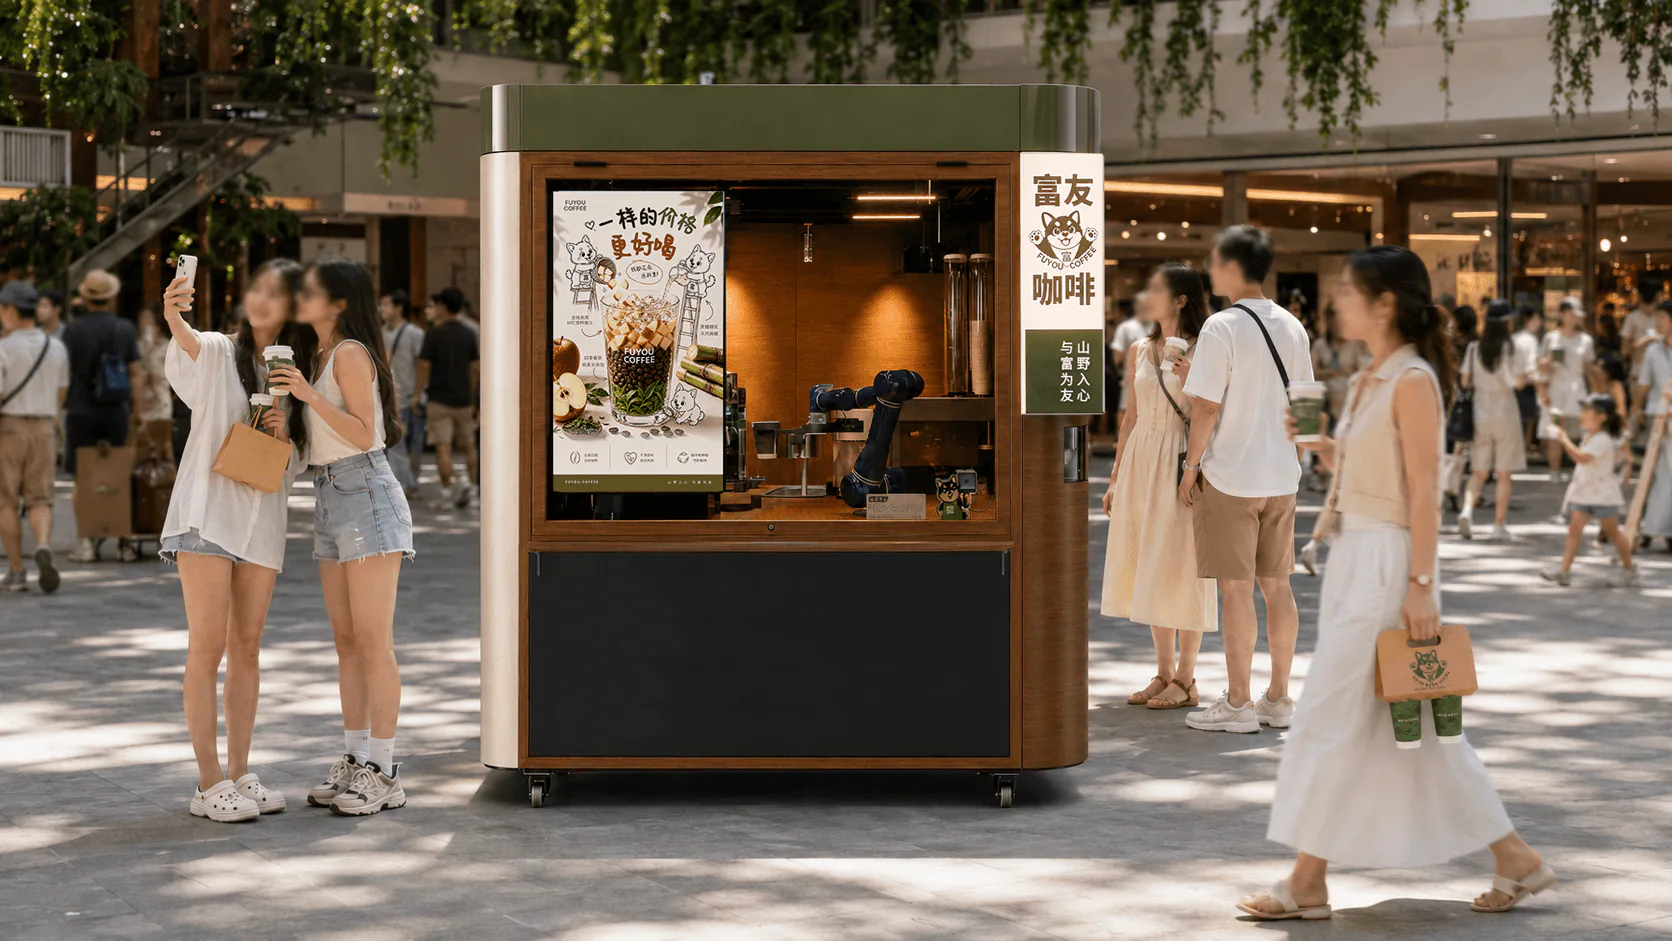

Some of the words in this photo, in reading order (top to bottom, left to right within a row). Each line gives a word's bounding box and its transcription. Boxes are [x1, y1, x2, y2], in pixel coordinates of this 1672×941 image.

[1033, 173, 1094, 208] 富友
[599, 207, 697, 235] 一样的价格
[611, 232, 677, 260] 更好喝
[1036, 252, 1064, 271] FUYOU
[1069, 246, 1097, 270] COFFEE
[1032, 272, 1096, 306] 咖啡
[623, 347, 655, 356] FUYOU
[623, 355, 656, 365] COFFEE
[1060, 340, 1074, 403] 与富为友
[1077, 340, 1091, 402] 山野入心
